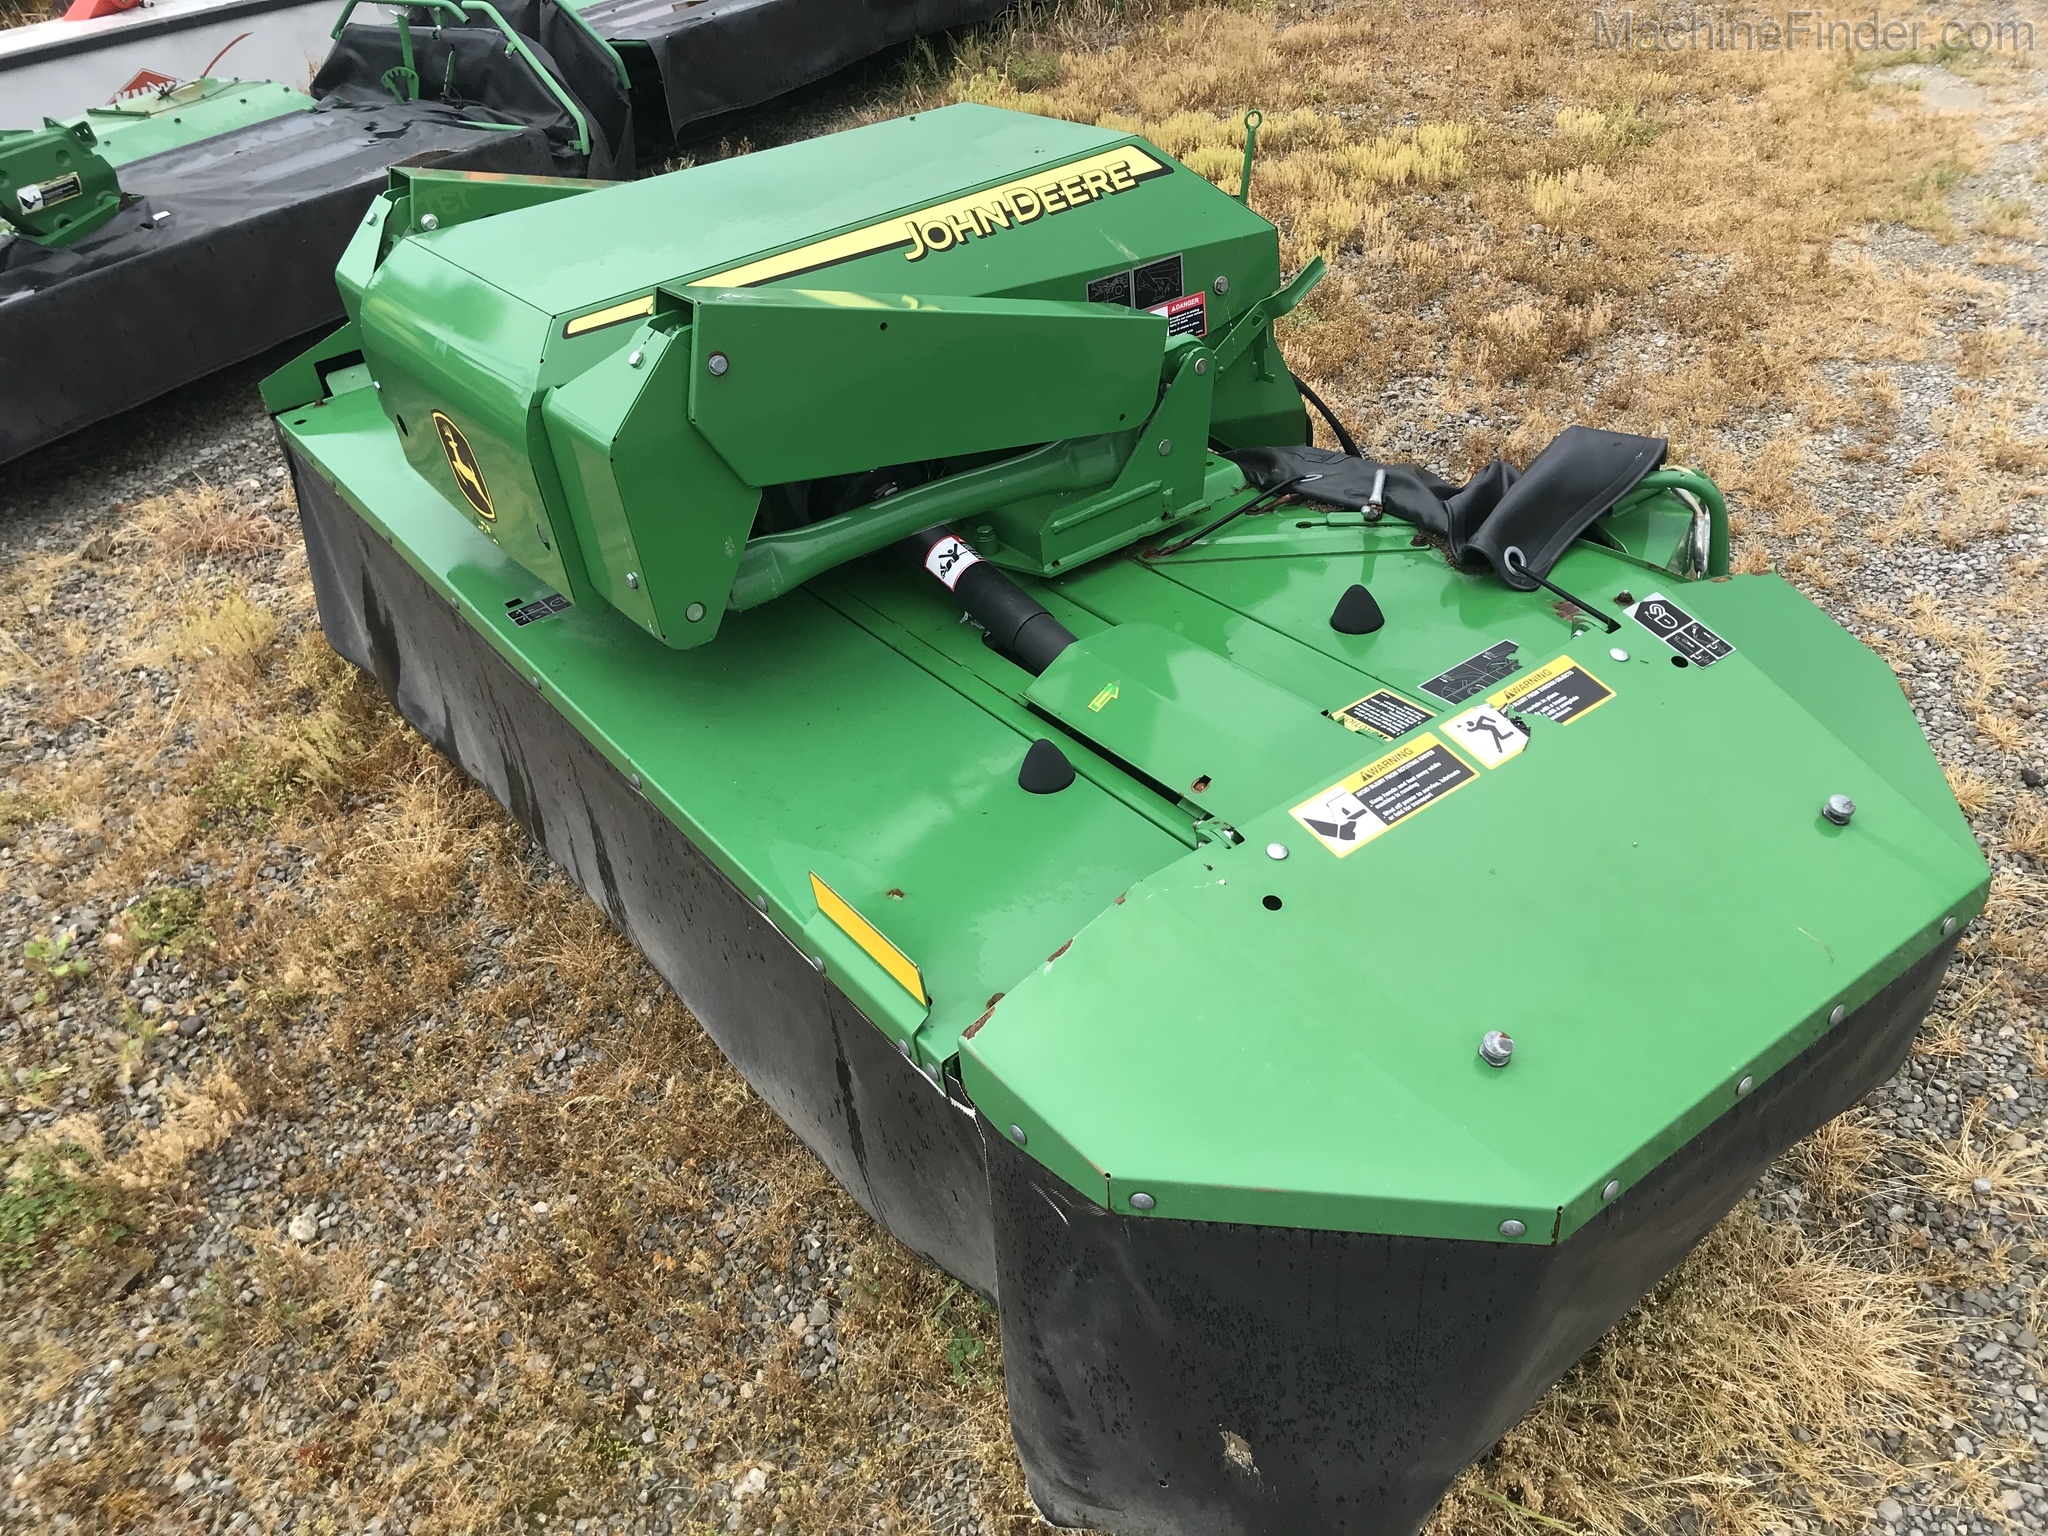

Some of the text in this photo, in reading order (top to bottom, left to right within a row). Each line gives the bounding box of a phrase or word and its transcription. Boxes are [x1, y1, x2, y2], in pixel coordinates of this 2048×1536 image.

[903, 160, 1140, 262] JOHN DEERE
[1176, 298, 1199, 309] DANGER
[1512, 669, 1552, 694] WARNING
[1513, 697, 1528, 707] INJURY
[1526, 690, 1540, 699] FROM
[1555, 670, 1574, 682] OBJECTS
[1367, 747, 1413, 775] WARNING
[1356, 786, 1370, 797] AVOID
[1369, 778, 1385, 789] INJURY
[1385, 771, 1399, 780] FROM
[1397, 759, 1420, 773] ROTATING
[1369, 796, 1383, 805] Keep
[1382, 787, 1398, 797] hands
[1397, 781, 1407, 789] and
[1416, 769, 1429, 779] away
[1428, 762, 1441, 771] while
[1375, 795, 1396, 809] machine
[1400, 782, 1420, 795] running
[1402, 795, 1417, 806] power
